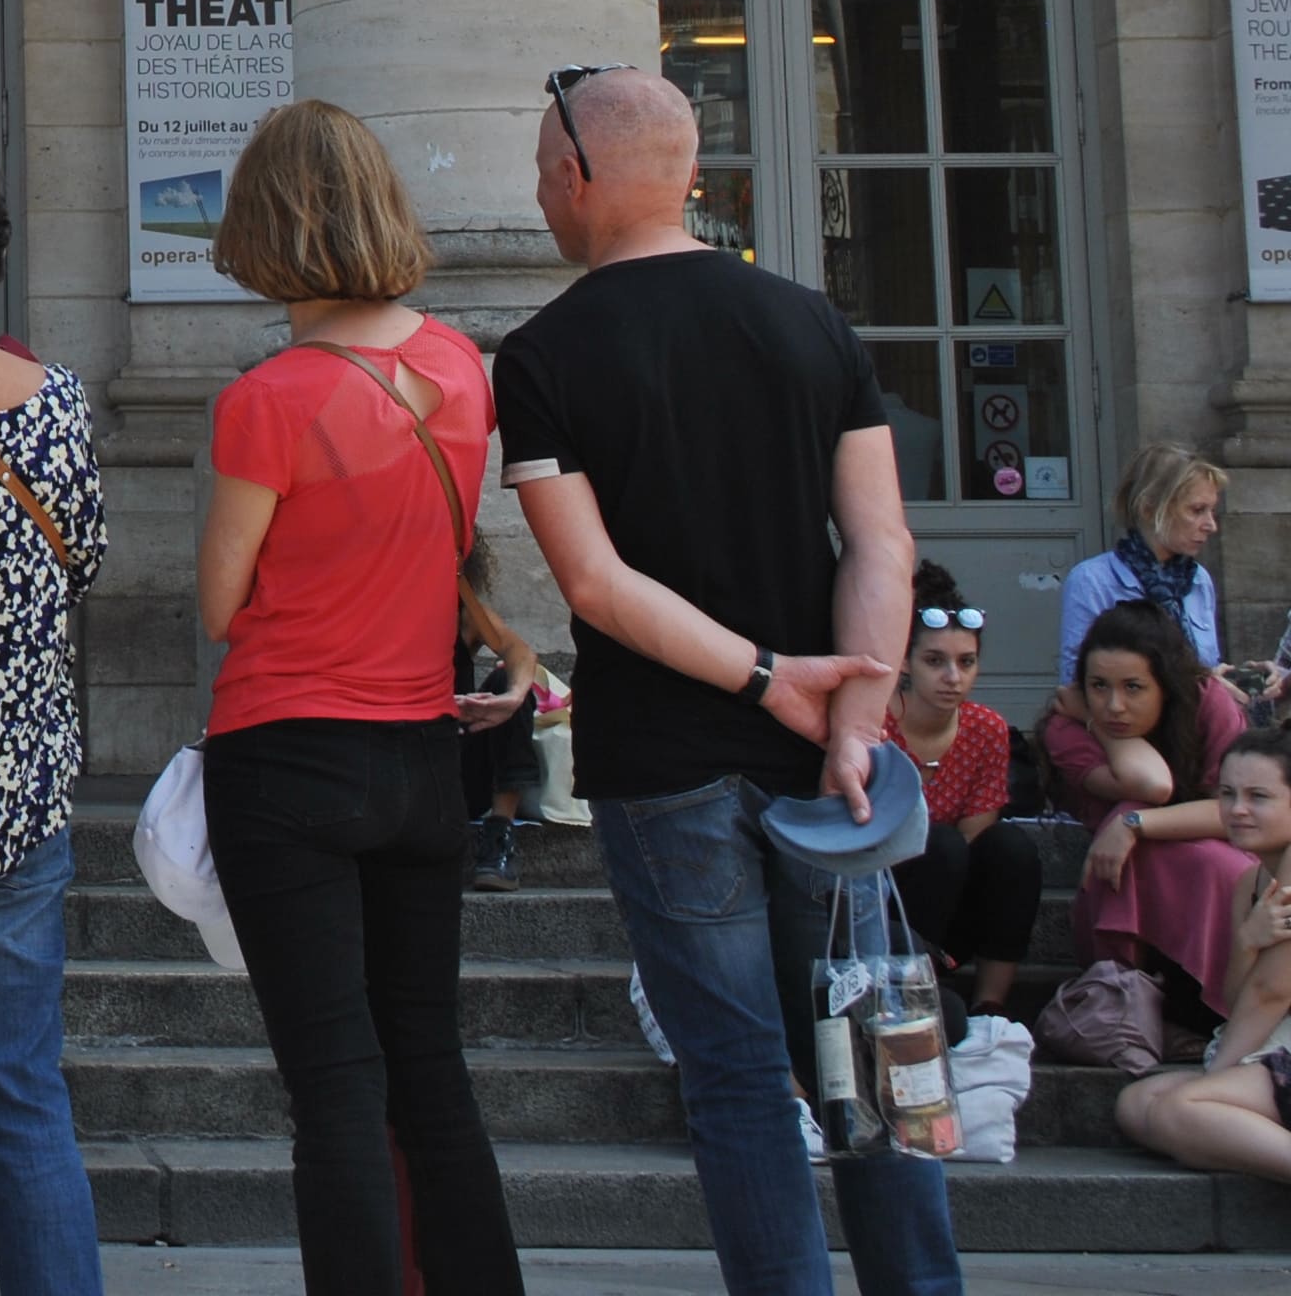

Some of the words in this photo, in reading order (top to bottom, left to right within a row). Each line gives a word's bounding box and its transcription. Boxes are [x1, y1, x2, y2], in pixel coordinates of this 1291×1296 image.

[1248, 19, 1291, 37] ROU
[136, 33, 201, 51] JOYAU
[206, 33, 233, 51] DE
[237, 33, 264, 51] LA
[1247, 43, 1291, 61] THE
[137, 58, 177, 75] DES
[182, 54, 285, 75] THÉÂTRES
[137, 80, 271, 99] HISTORIQUES
[138, 120, 159, 133] Du
[163, 120, 181, 133] 12
[183, 119, 227, 135] juillet
[229, 122, 248, 133] au
